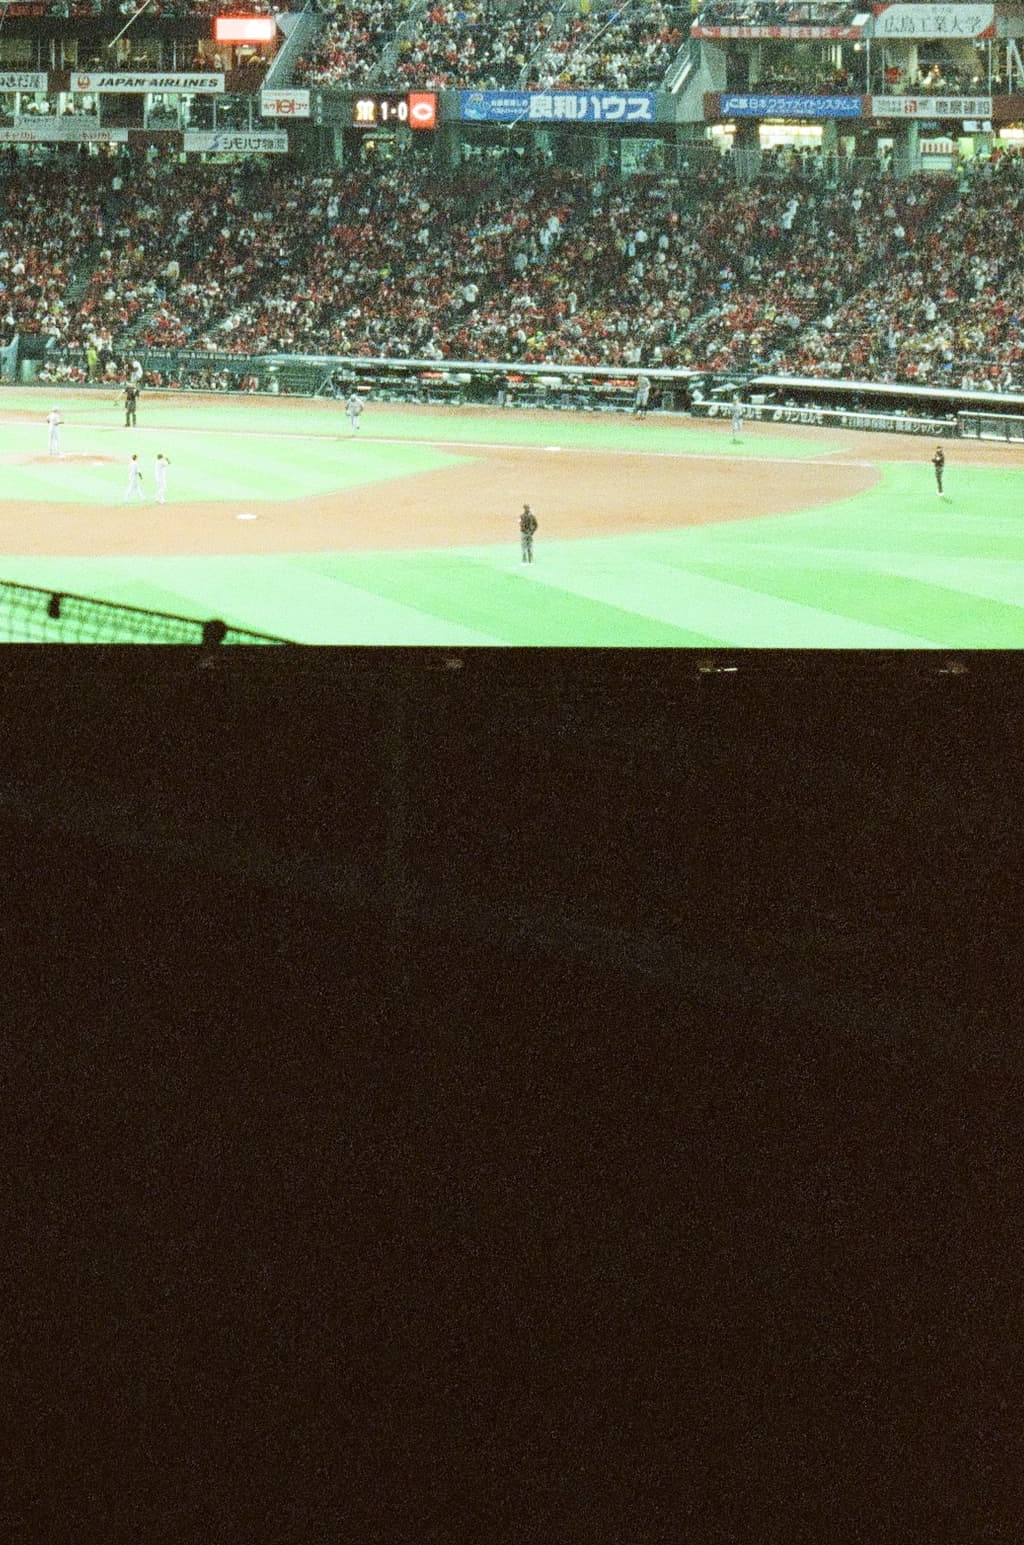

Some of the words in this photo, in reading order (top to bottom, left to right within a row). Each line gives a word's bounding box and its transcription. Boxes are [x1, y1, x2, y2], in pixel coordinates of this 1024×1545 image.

[883, 15, 982, 33] 広島工業大学
[96, 78, 145, 87] JAPAN
[150, 78, 218, 87] AIRLINES
[528, 94, 652, 120] 良和ハウス
